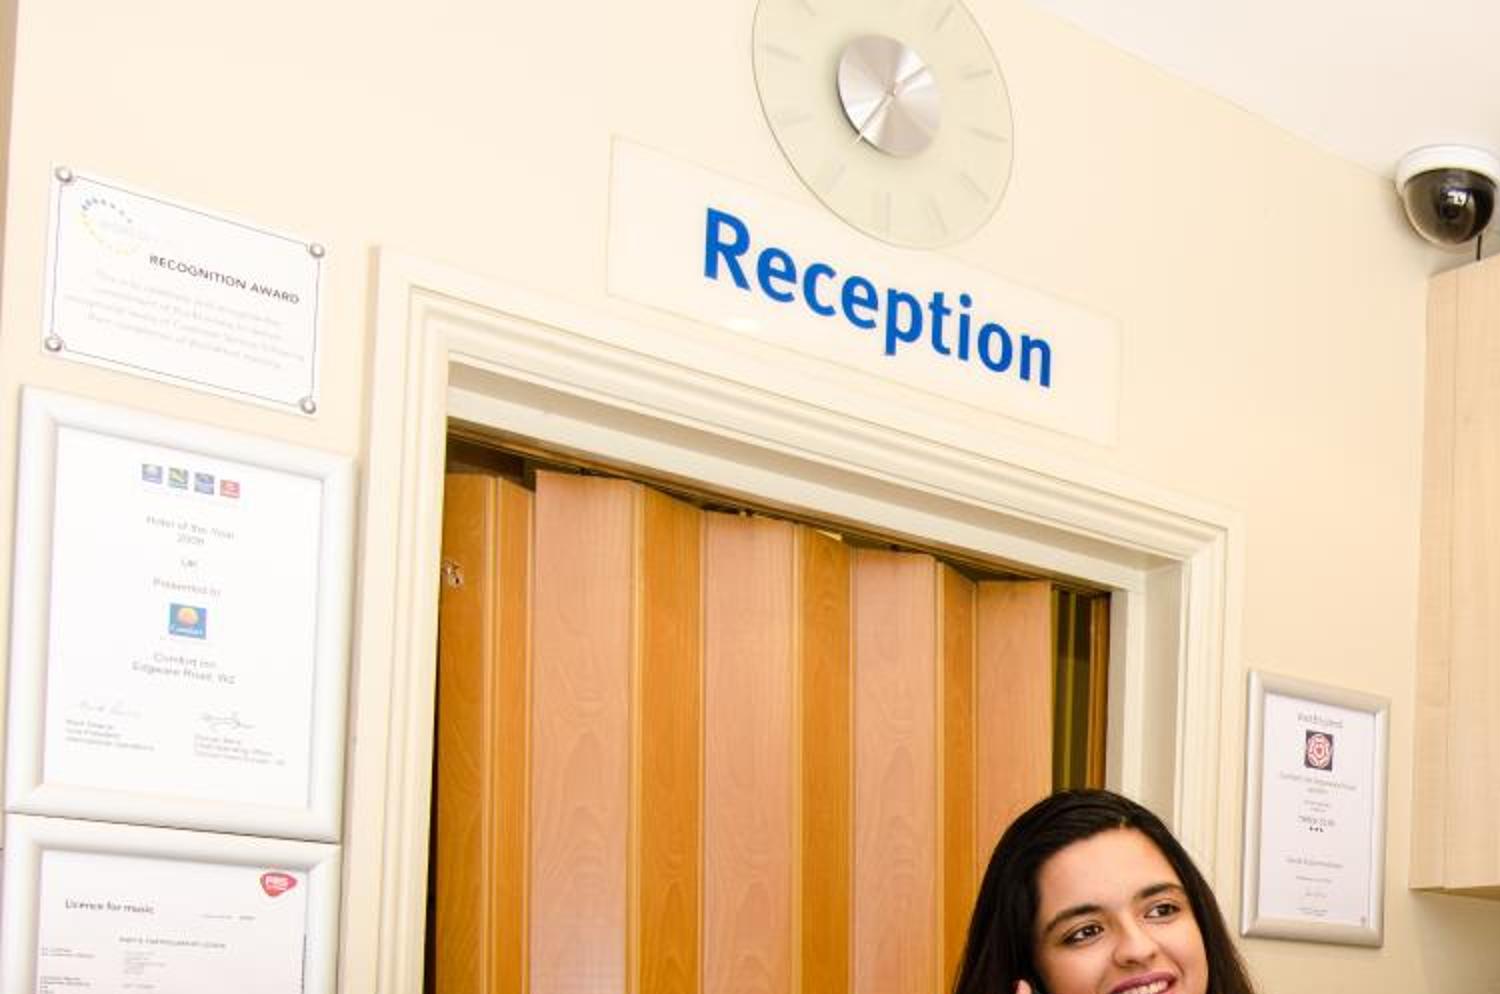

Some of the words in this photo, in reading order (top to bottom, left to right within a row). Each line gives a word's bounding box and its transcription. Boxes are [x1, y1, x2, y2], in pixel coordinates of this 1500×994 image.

[149, 255, 247, 289] RECOGNITION
[250, 283, 300, 305] AWARD
[704, 207, 1052, 388] Reception
[106, 900, 122, 911] for
[123, 903, 156, 915] music
